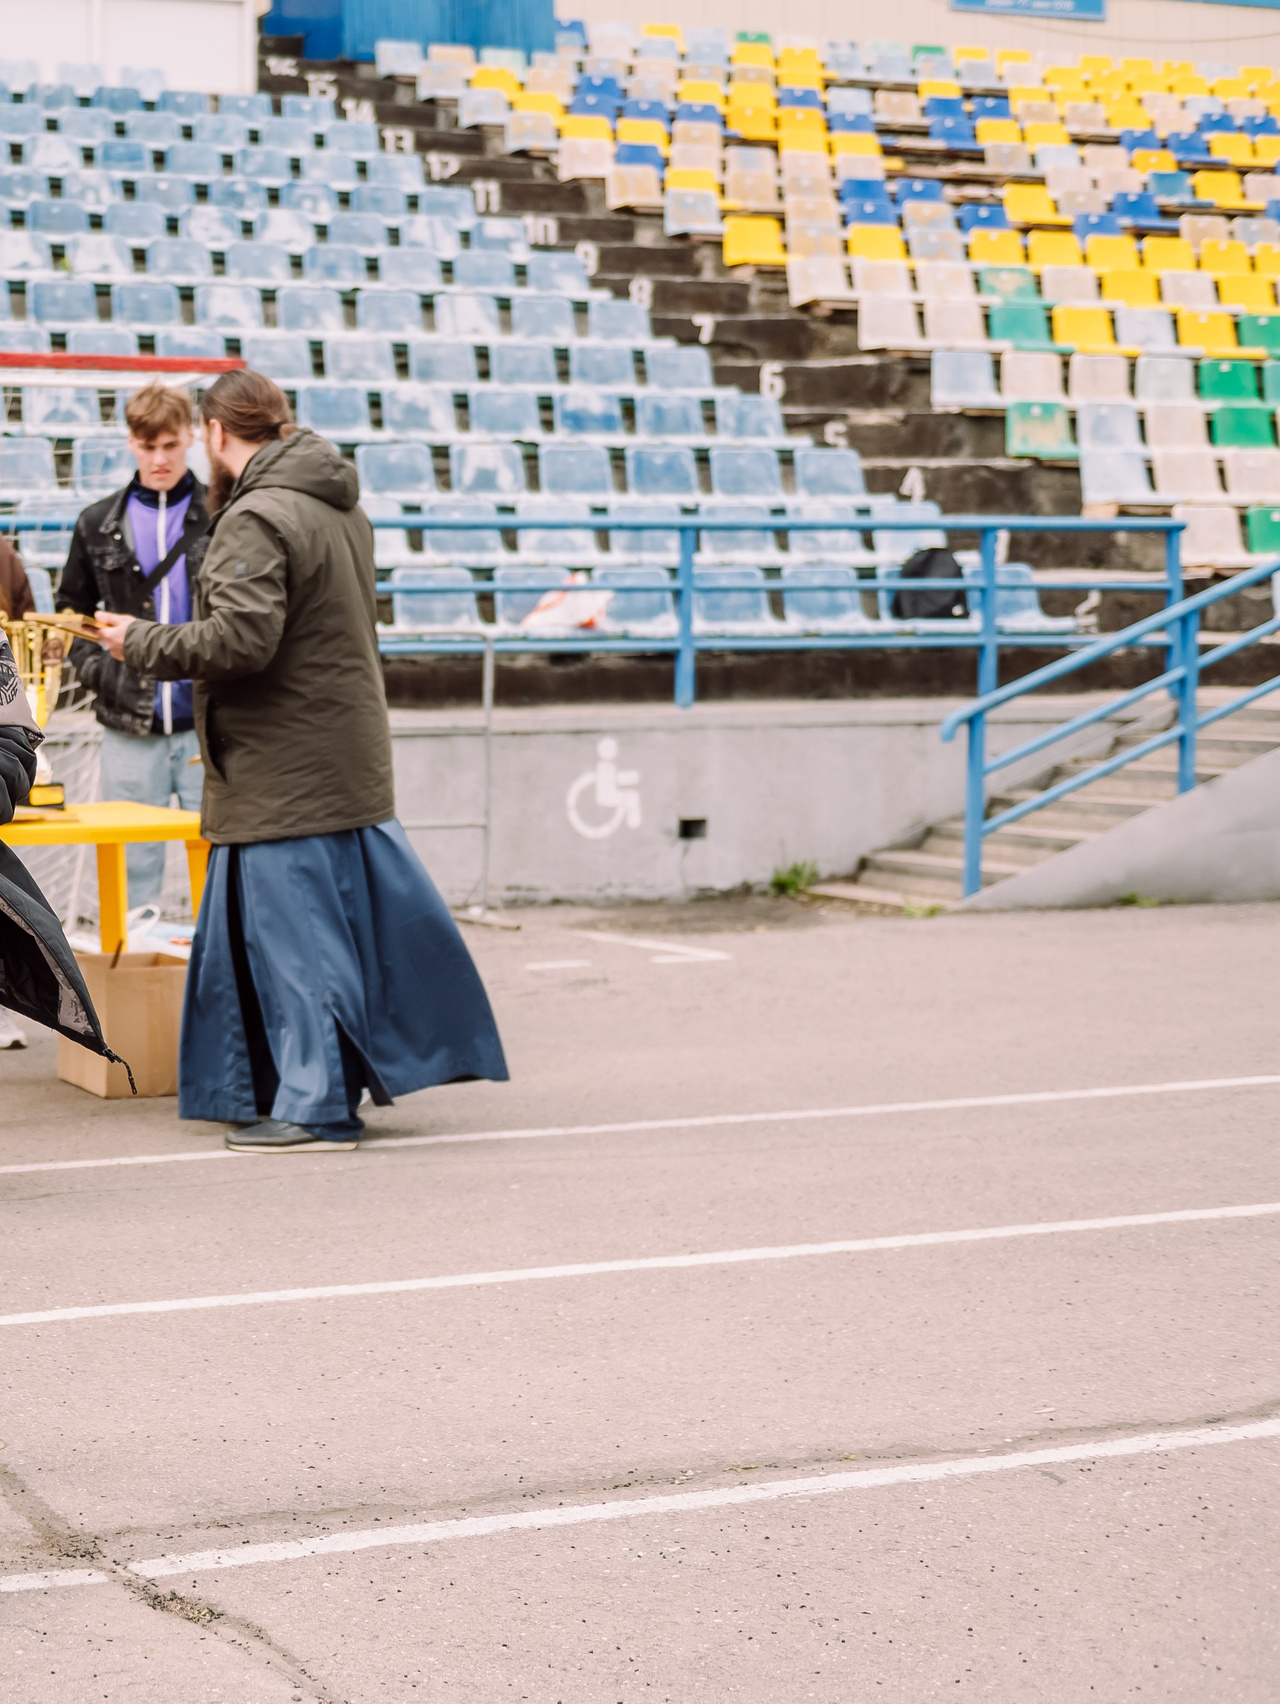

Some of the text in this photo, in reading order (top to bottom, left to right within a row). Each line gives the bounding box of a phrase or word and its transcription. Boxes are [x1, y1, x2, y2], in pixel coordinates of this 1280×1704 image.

[472, 182, 499, 214] 11
[575, 240, 599, 276] 9
[691, 314, 715, 344] 7
[759, 361, 786, 400] 6
